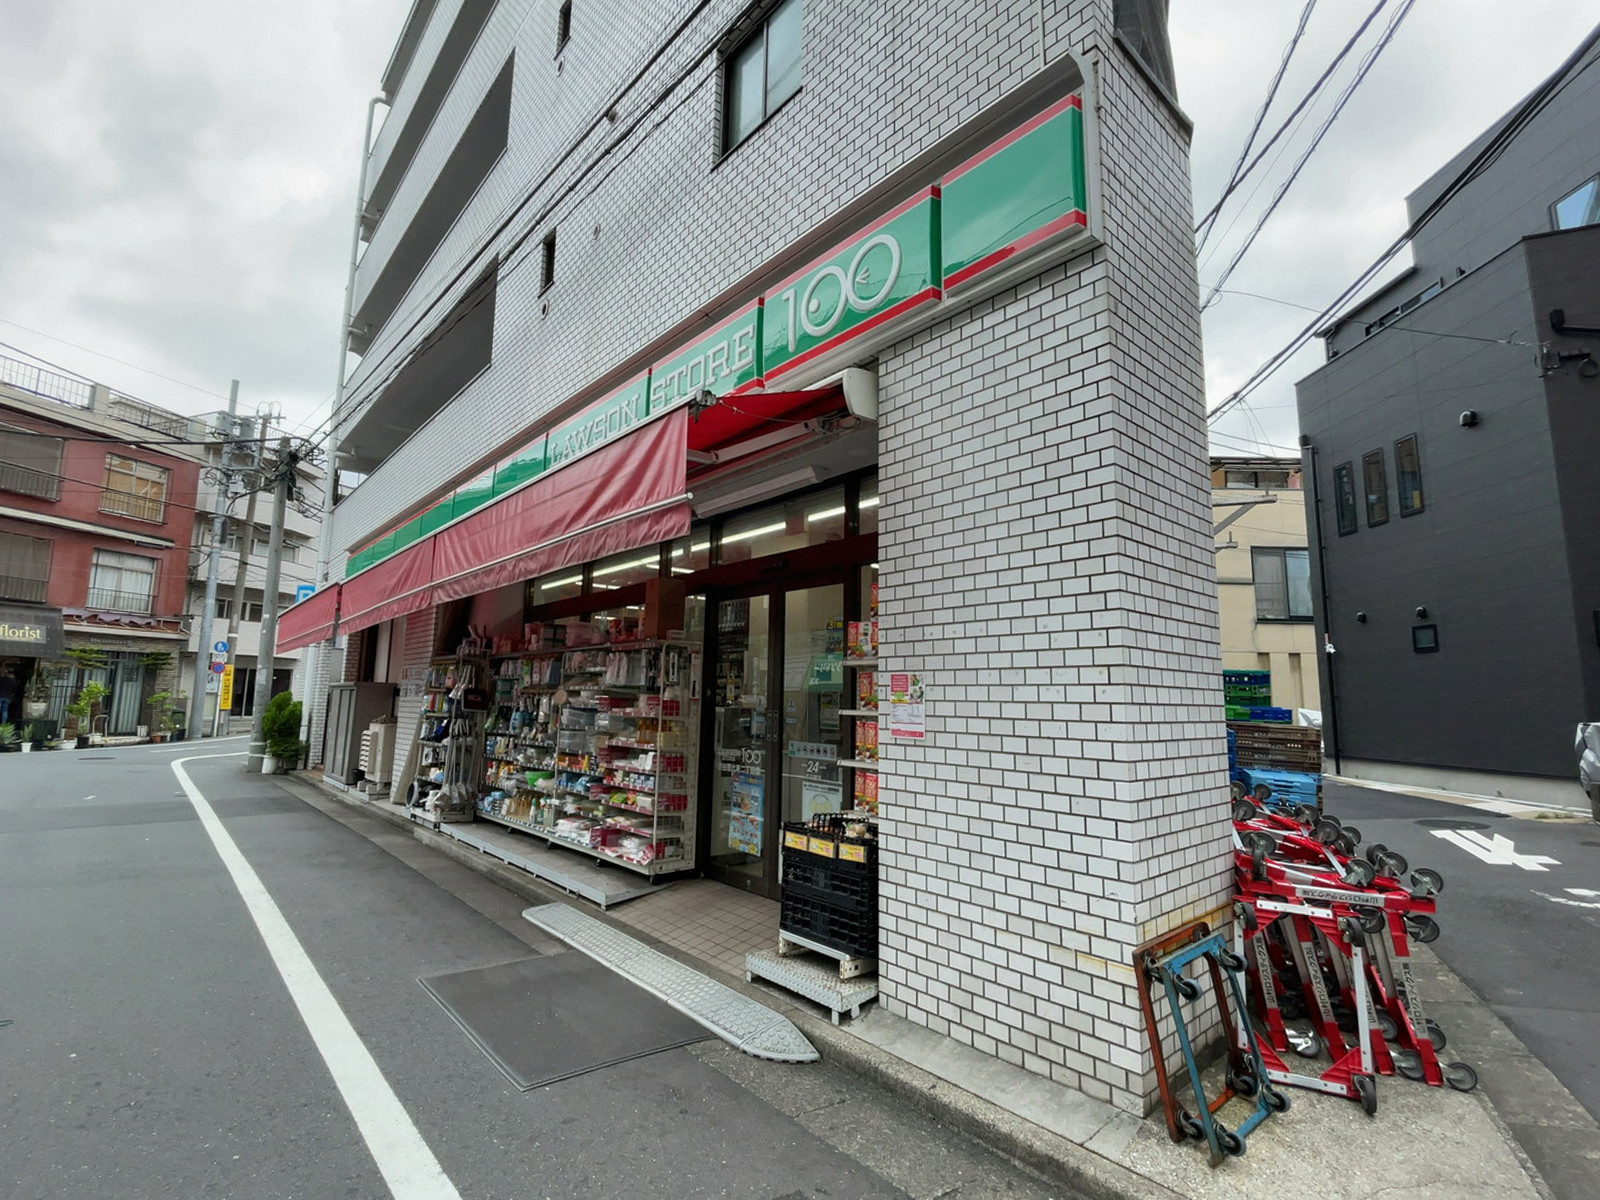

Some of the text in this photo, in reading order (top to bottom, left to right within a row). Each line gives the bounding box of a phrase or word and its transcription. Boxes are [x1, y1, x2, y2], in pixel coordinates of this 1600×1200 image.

[548, 233, 902, 467] LAWSON STORE 100
[0, 623, 41, 639] florist
[806, 760, 819, 774] 24
